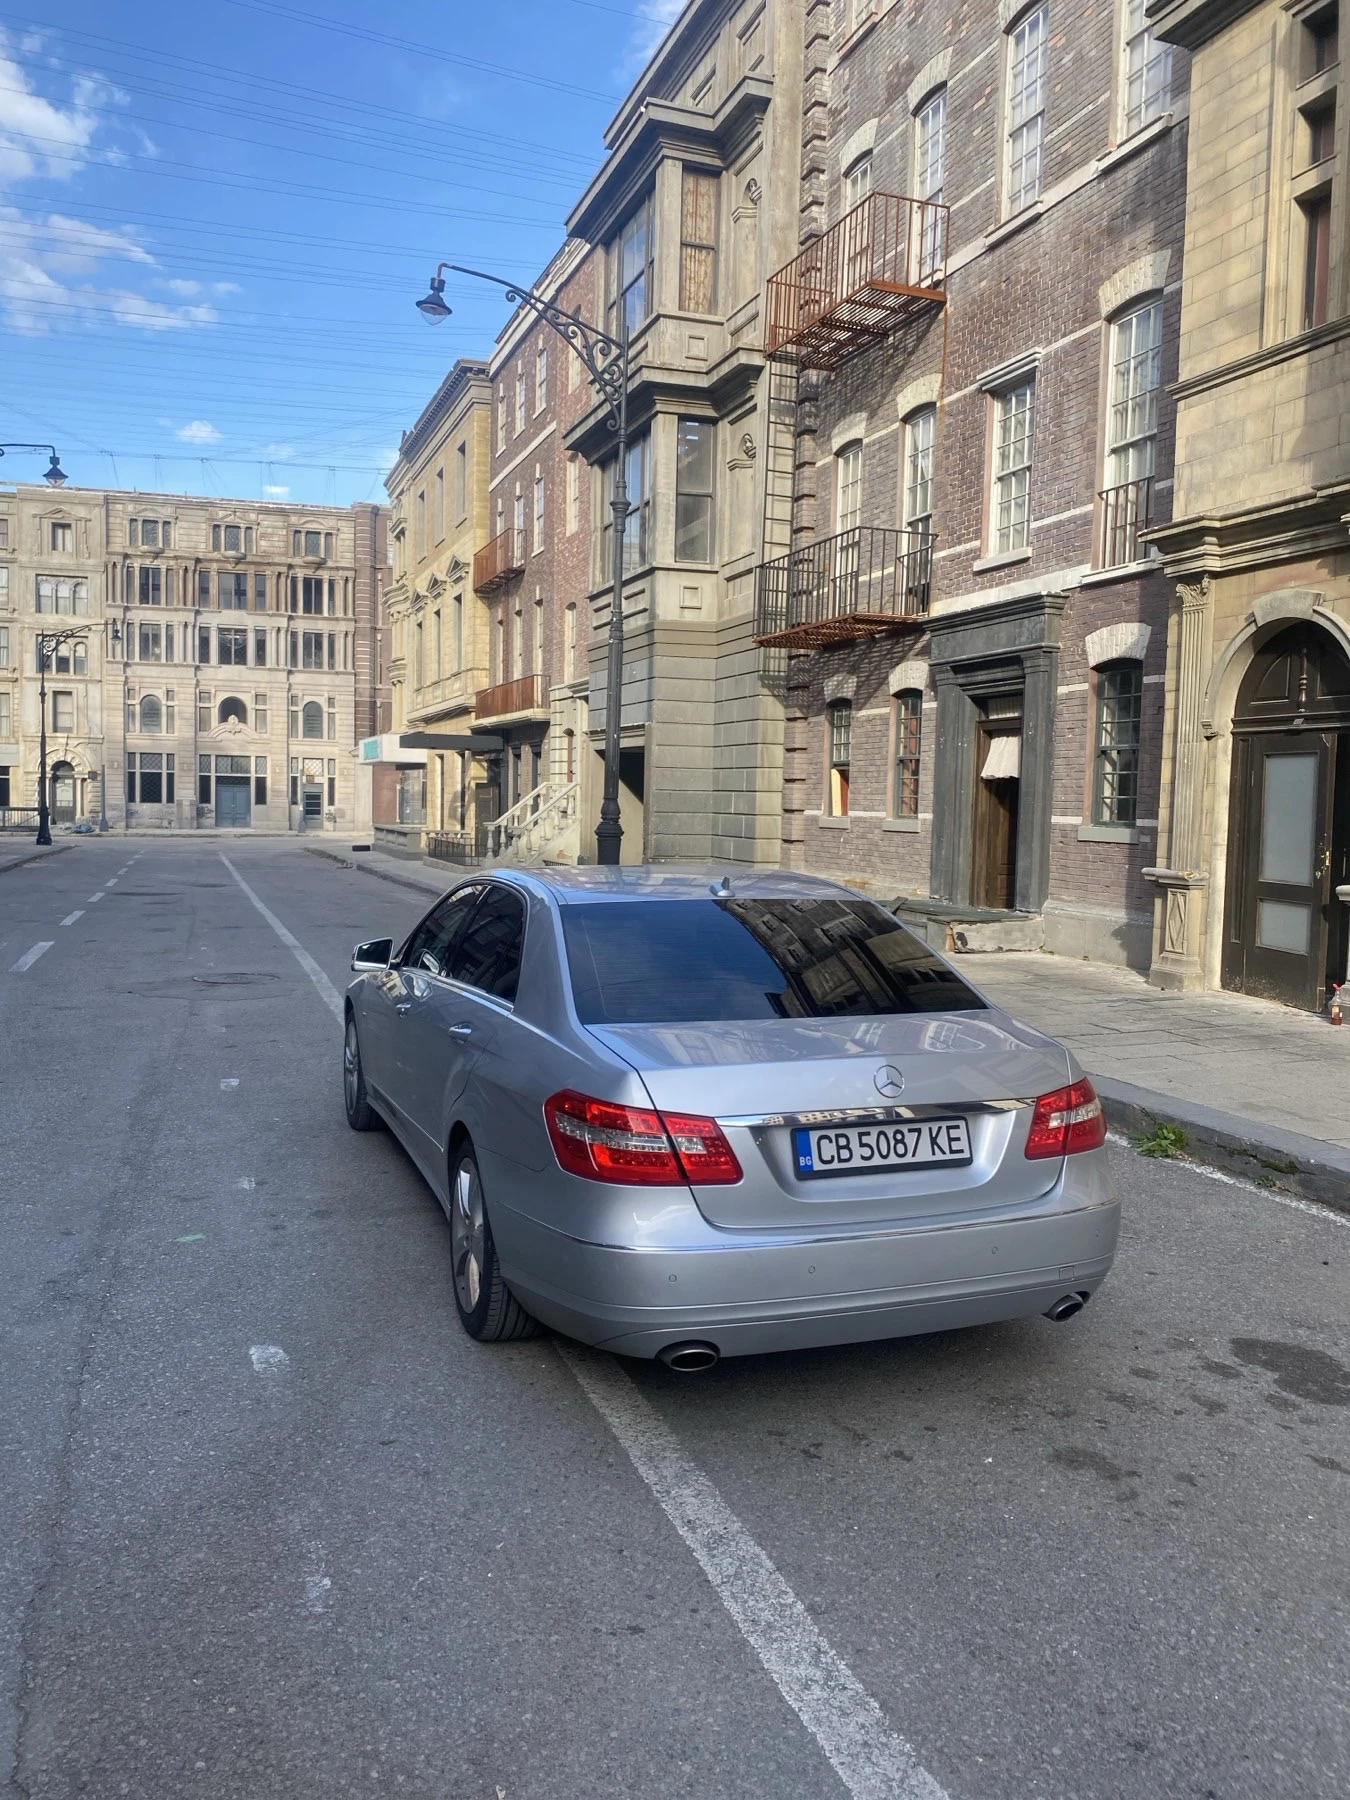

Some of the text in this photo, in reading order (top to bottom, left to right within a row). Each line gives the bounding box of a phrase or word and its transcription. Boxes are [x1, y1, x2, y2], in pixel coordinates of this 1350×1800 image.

[816, 1125, 965, 1165] CB 5087 KE
[799, 1156, 812, 1166] BG
